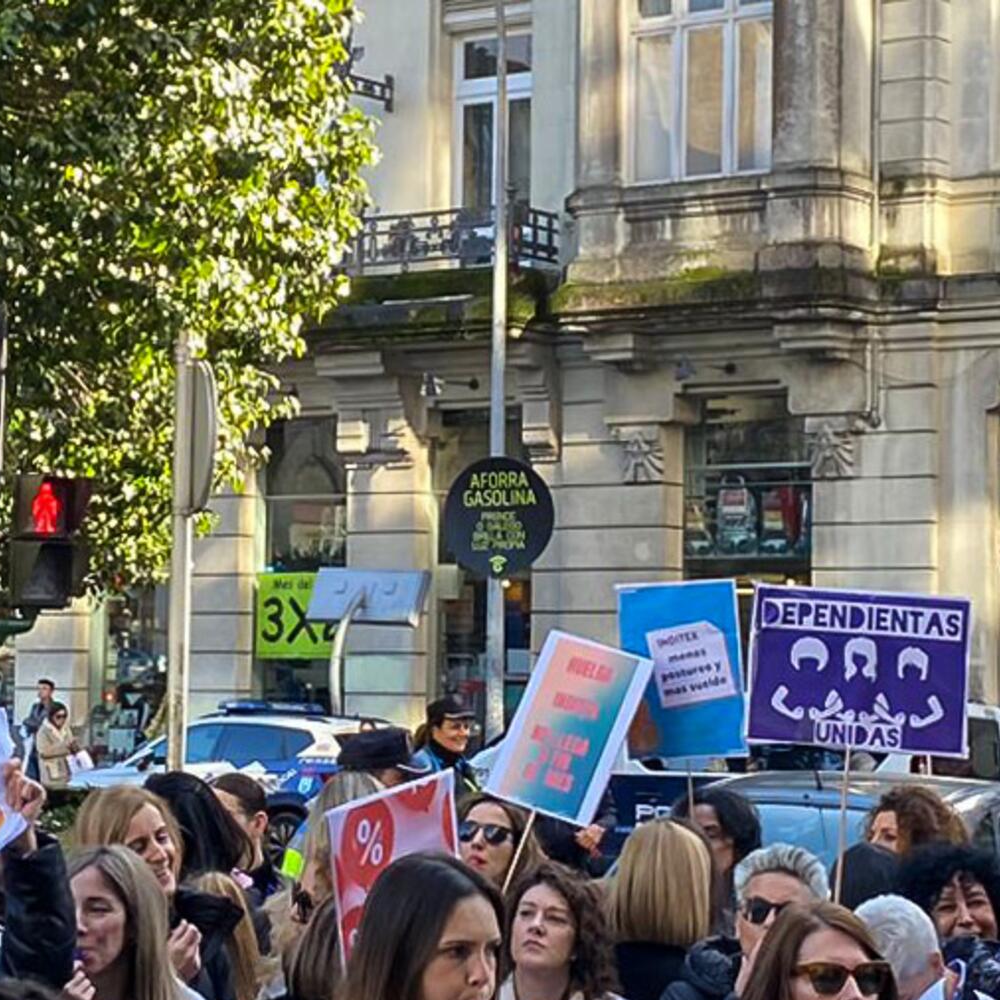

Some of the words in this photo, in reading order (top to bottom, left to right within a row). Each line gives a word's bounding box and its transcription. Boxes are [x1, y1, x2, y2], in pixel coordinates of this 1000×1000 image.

[470, 471, 529, 489] AFORRA
[462, 489, 537, 507] GASOLINA
[763, 601, 960, 637] DEPENDIENTAS
[816, 722, 899, 748] UNIDAS
